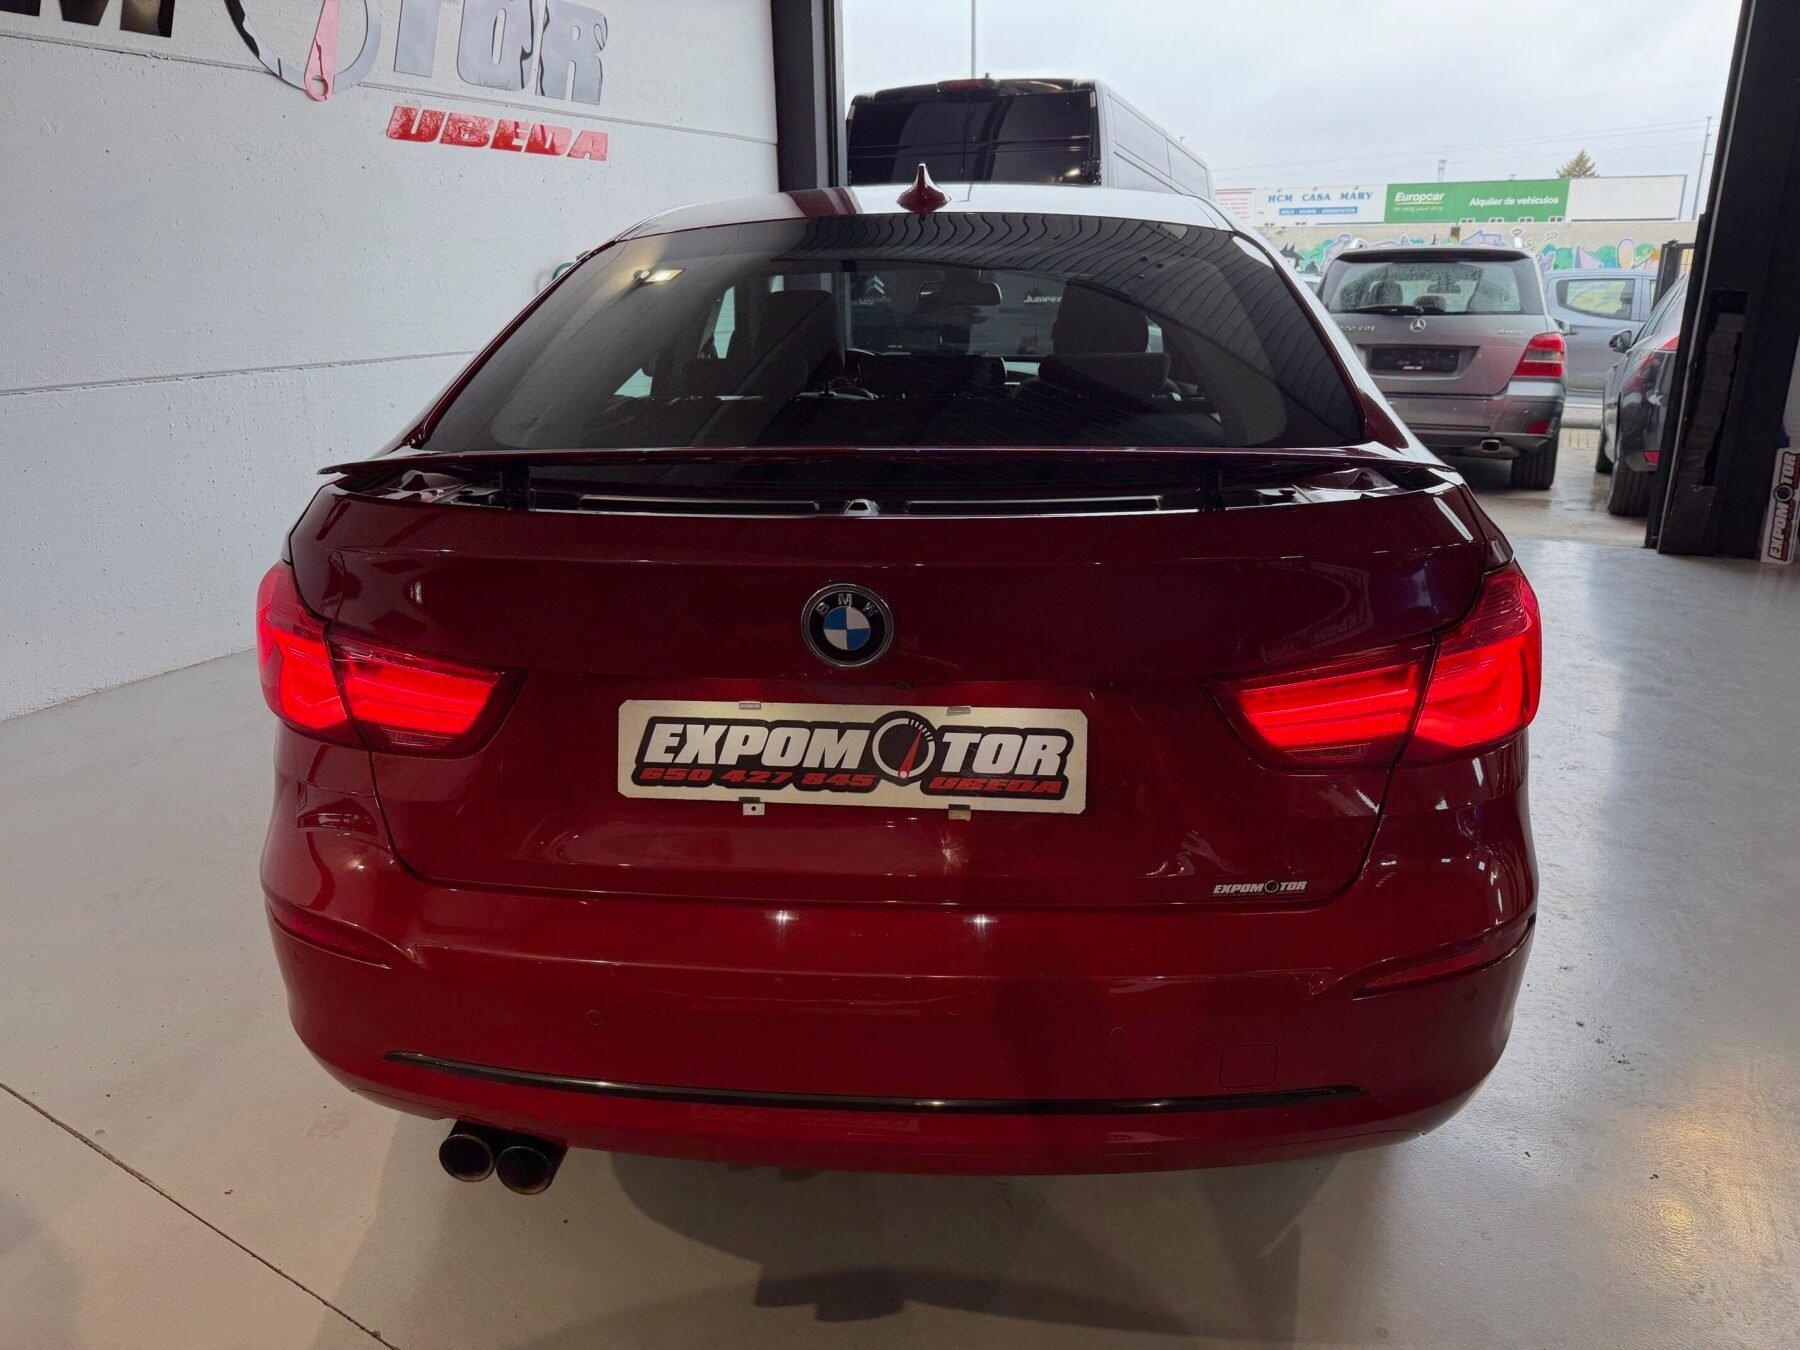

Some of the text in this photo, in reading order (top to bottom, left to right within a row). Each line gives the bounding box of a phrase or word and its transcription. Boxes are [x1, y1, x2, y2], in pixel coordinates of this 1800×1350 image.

[386, 106, 608, 161] UBEDA
[1268, 191, 1374, 203] HCM CASA MARY
[1394, 192, 1446, 204] Europcar
[1469, 197, 1502, 208] Alquiler
[1504, 196, 1516, 206] de
[814, 593, 879, 617] BMW
[640, 767, 1062, 794] 650 427 845 UBEDA
